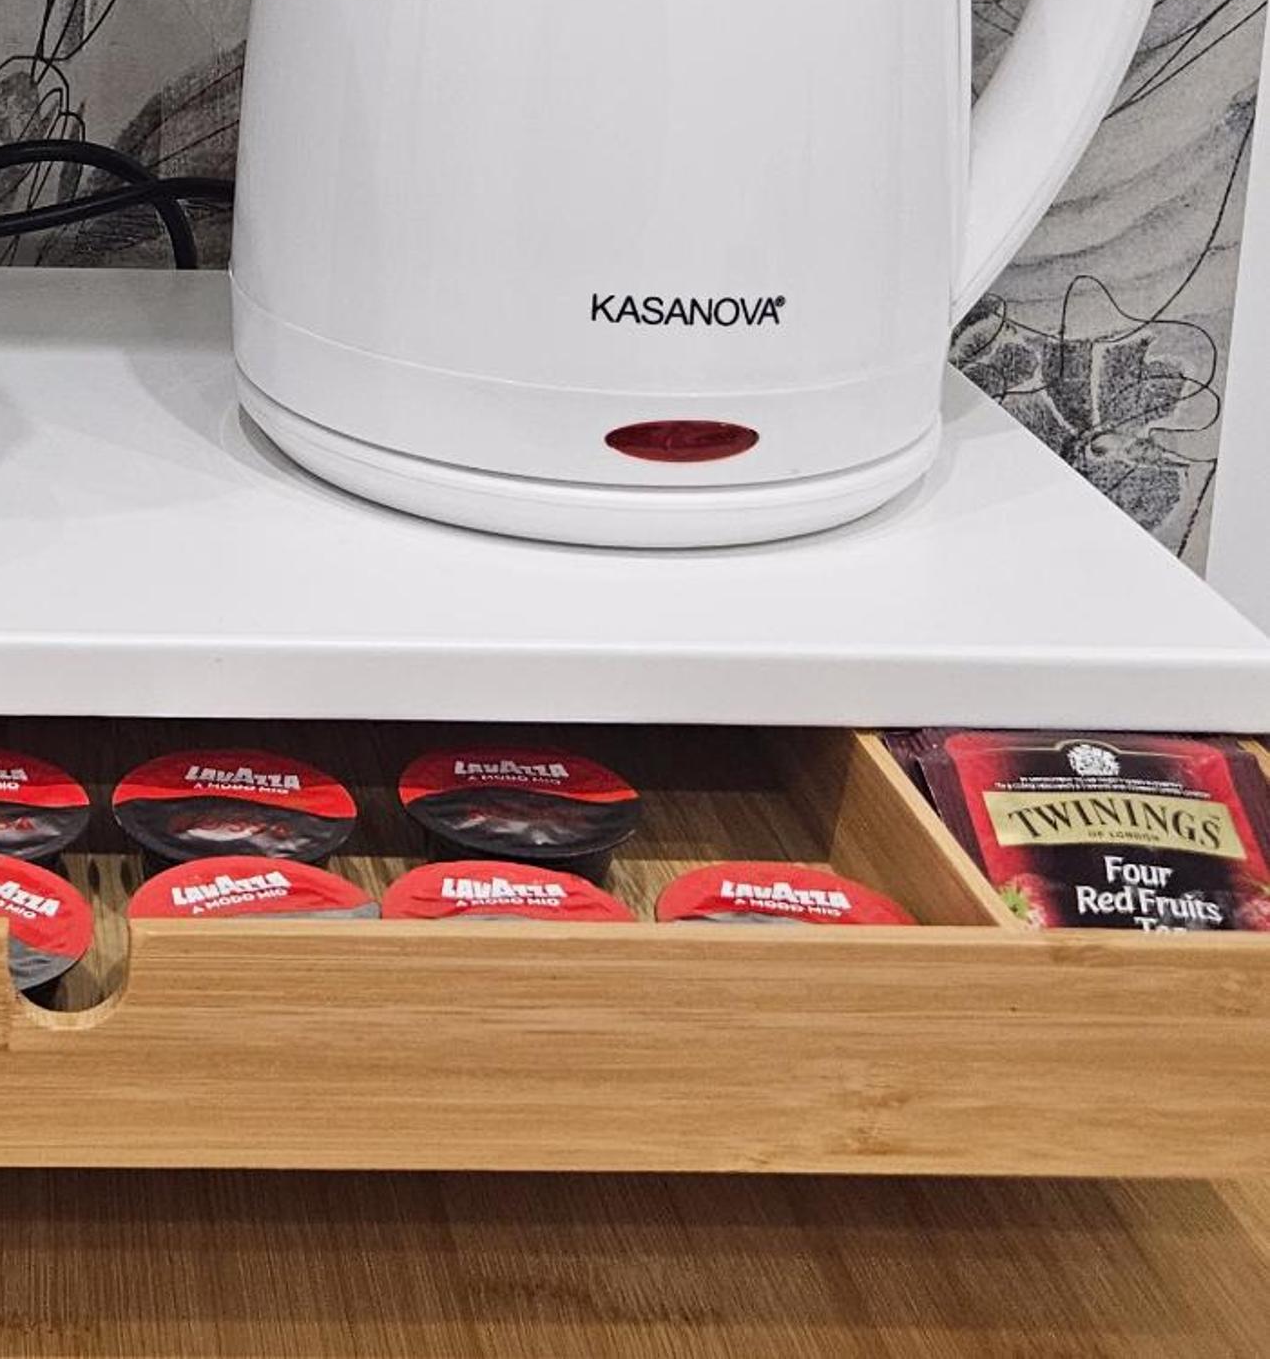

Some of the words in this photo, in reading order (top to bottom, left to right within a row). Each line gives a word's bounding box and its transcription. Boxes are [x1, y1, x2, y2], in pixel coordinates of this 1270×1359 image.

[185, 765, 300, 790] LAVAZZA
[454, 760, 569, 777] LAVAZZA
[1007, 796, 1222, 850] TWININGS
[1103, 855, 1174, 888] Four
[172, 870, 292, 906] LAVAZZA
[441, 877, 567, 899] LAVAZZA
[720, 880, 852, 910] LAVAZZA
[5, 904, 37, 920] MIO
[192, 905, 204, 914] A
[205, 894, 257, 911] MODO
[258, 889, 289, 900] MIO
[456, 898, 466, 907] A
[468, 897, 525, 907] MODO
[526, 897, 560, 907] MIO
[749, 898, 805, 912] MODO
[808, 904, 843, 917] MIO
[1075, 885, 1136, 915] Red
[1137, 887, 1223, 924] Fruits
